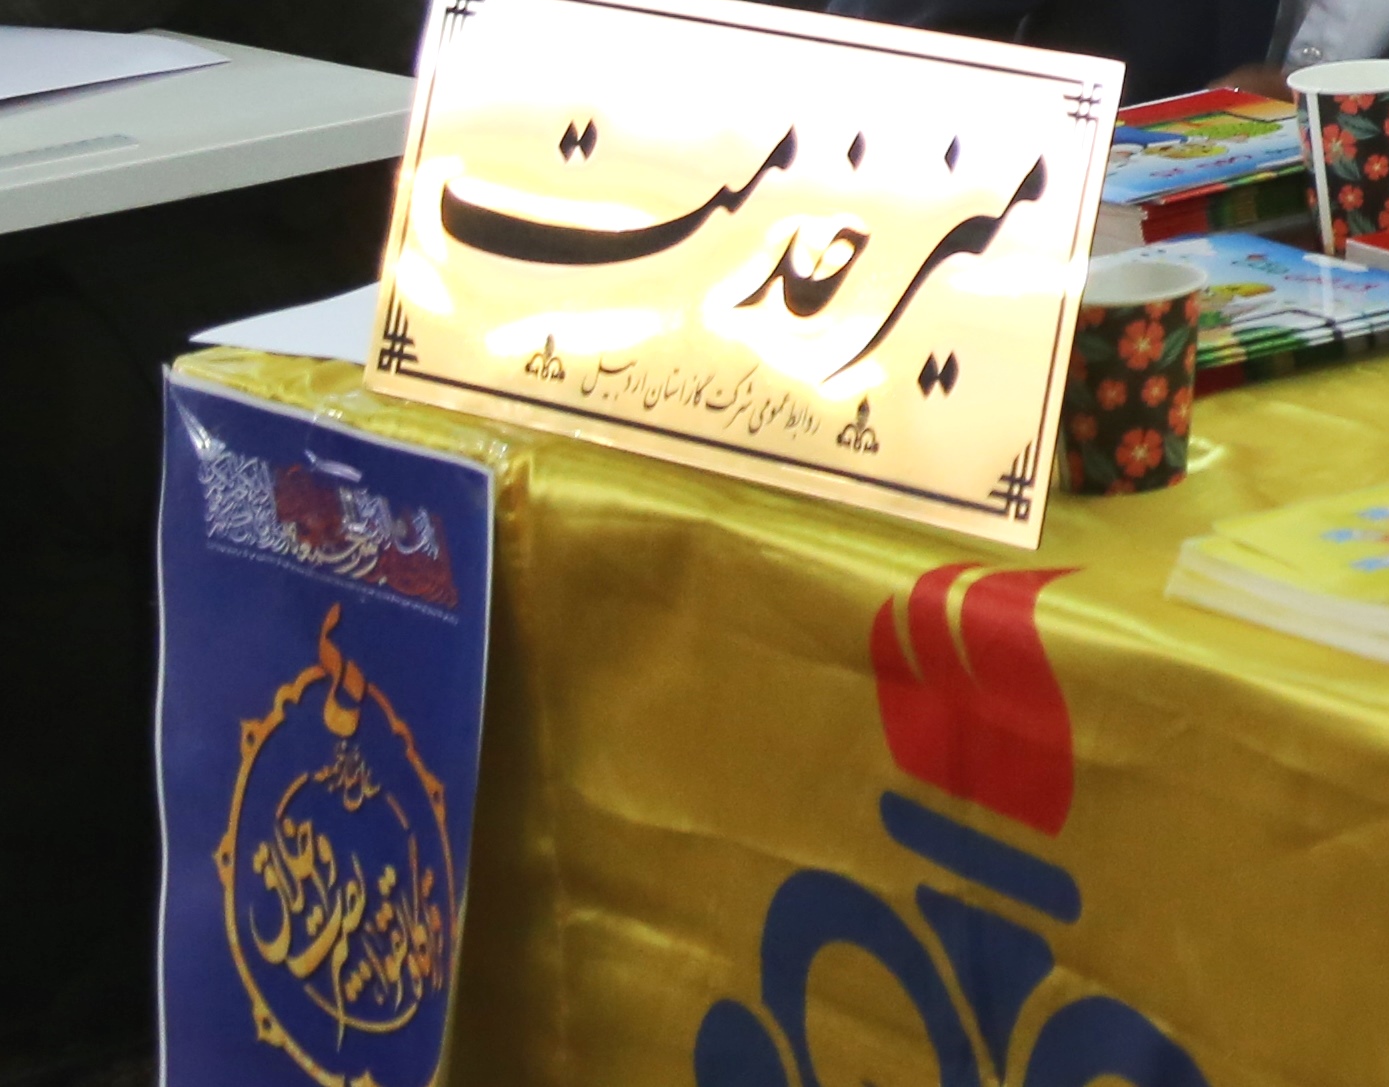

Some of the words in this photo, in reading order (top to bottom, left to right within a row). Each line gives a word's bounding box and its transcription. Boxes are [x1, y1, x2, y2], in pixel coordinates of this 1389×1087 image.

[441, 117, 870, 317] خدمت
[822, 134, 1046, 398] میز
[580, 358, 648, 402] اردبیل
[682, 374, 715, 408] گاز
[704, 362, 759, 430] شرکت
